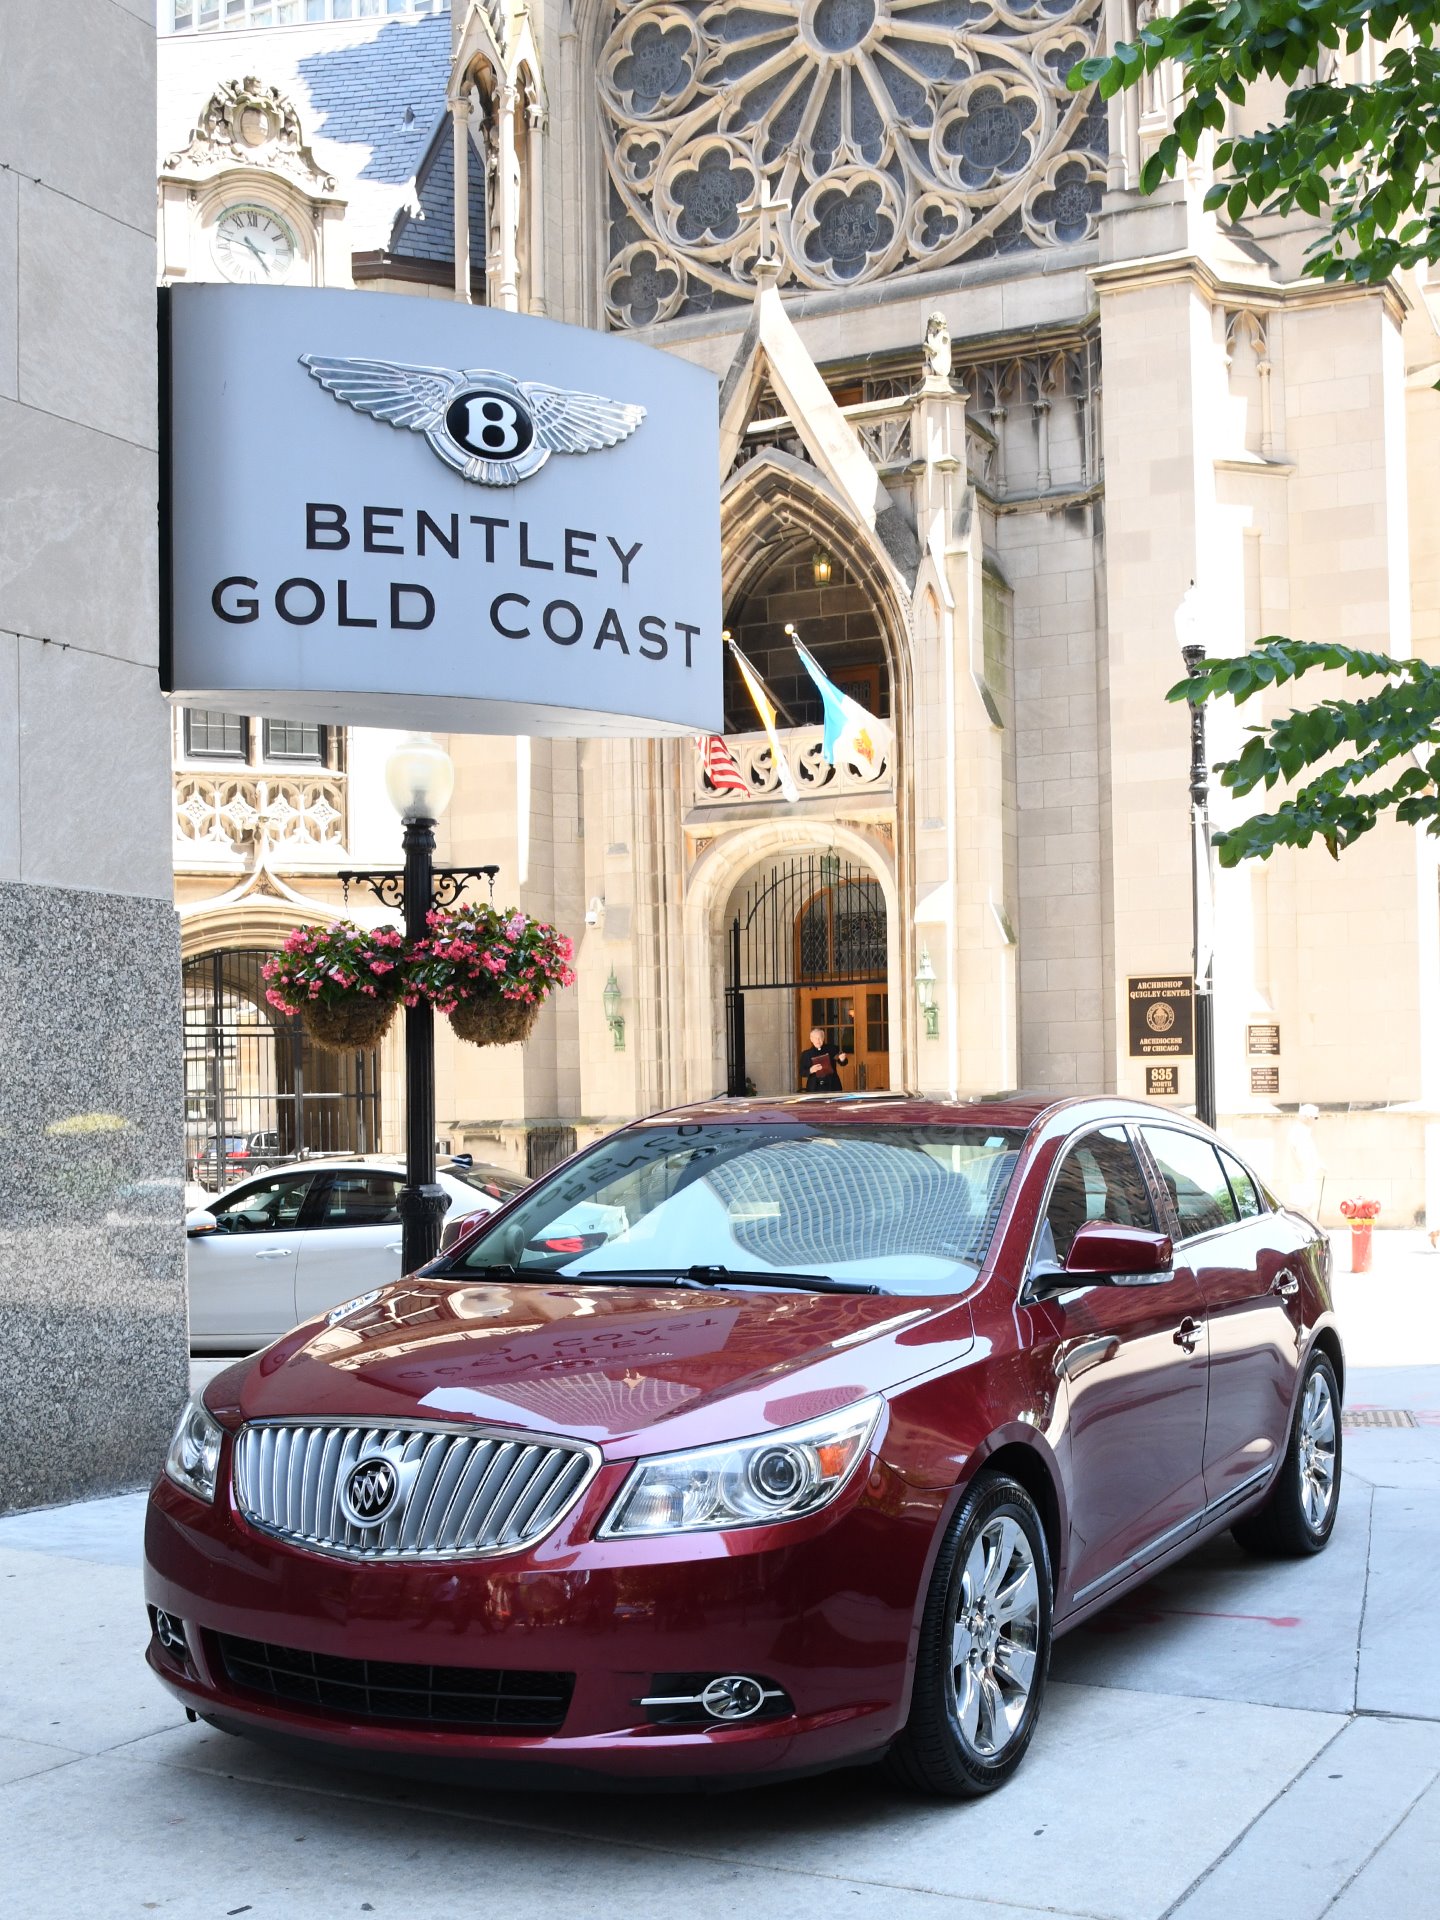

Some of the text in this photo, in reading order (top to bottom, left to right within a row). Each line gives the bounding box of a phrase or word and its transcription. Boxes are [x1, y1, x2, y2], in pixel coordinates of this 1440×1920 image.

[465, 396, 520, 453] B
[305, 502, 643, 584] BENTLEY
[211, 575, 701, 668] GOLD COAST
[1130, 989, 1191, 999] QUIGLEY CENTER
[1137, 981, 1183, 989] ARCHBISHOP
[1151, 1068, 1173, 1081] 835
